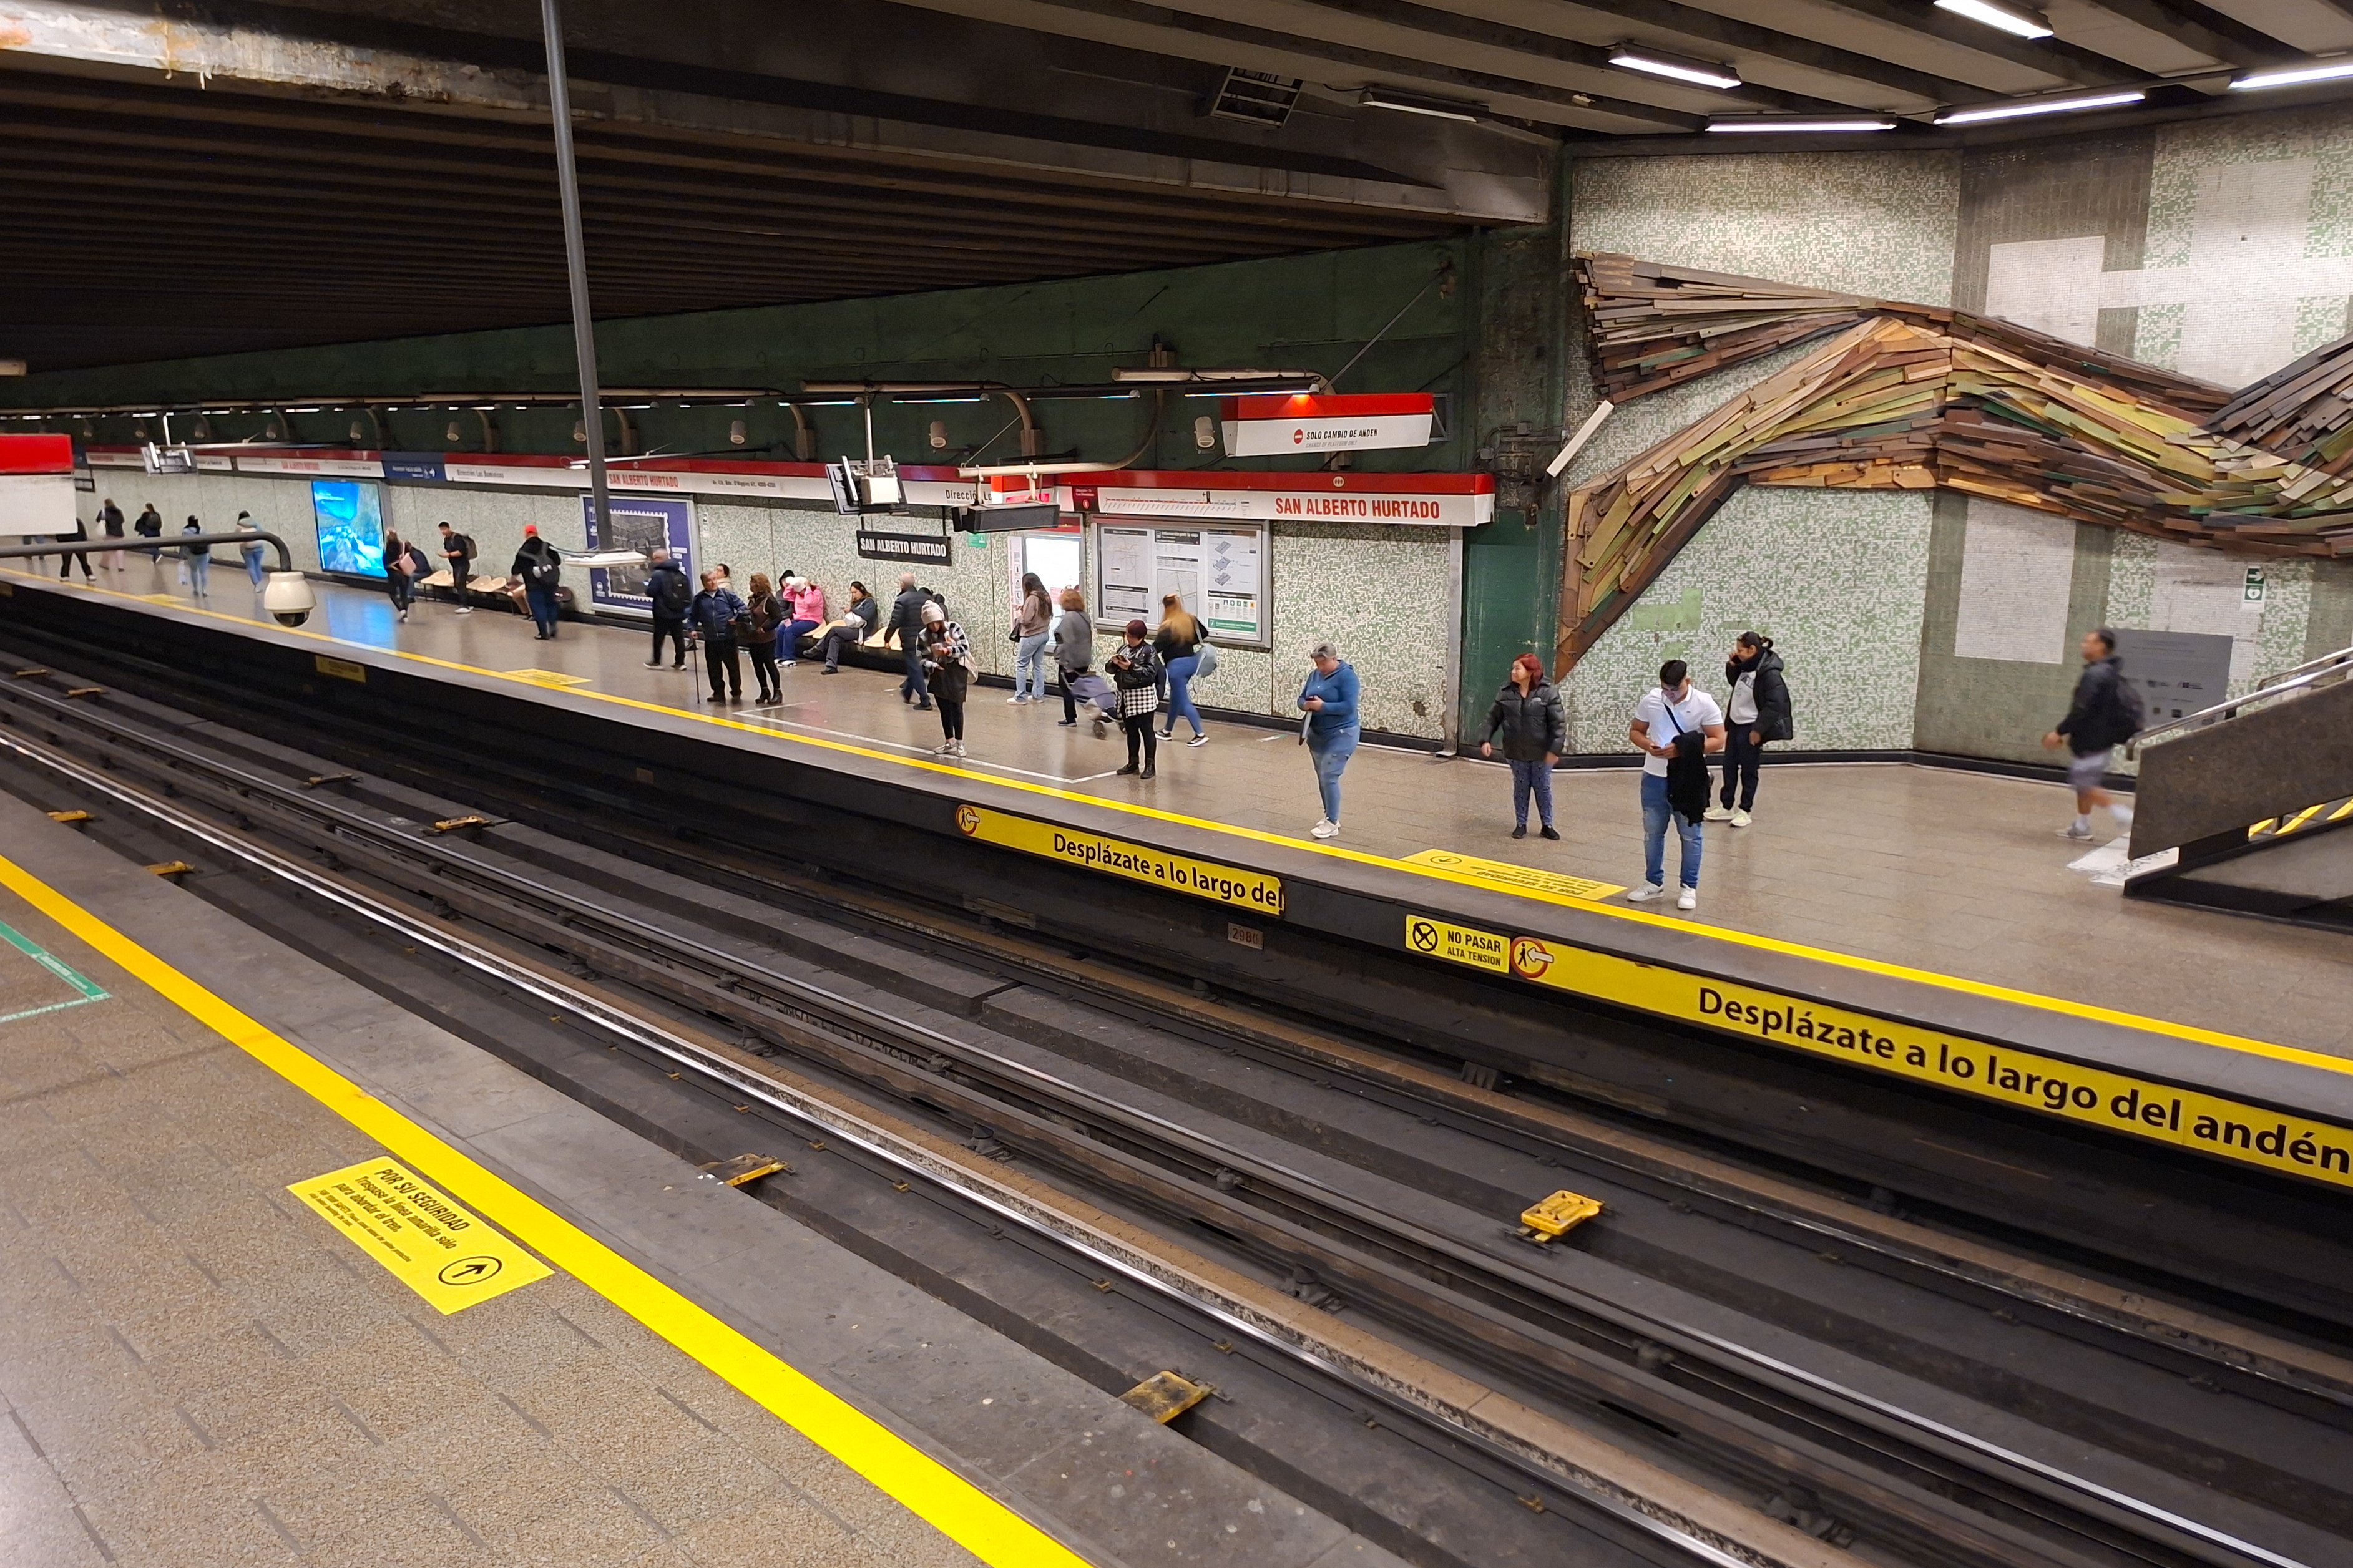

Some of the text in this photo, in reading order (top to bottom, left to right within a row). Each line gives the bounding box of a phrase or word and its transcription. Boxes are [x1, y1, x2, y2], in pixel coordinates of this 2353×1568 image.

[1306, 429, 1378, 440] SOLO CAMBIO DE ANDEN
[609, 474, 679, 488] SAN ALBERTO HURTADO
[946, 489, 992, 501] Direcció Lo
[1276, 497, 1440, 519] SAN ALBERTO HURTADO
[860, 537, 946, 557] SAN ALBERTO HURTADO
[1054, 833, 1283, 908] Desplázate a lo largo del
[1447, 930, 1501, 953] NO PASAR
[1447, 946, 1501, 967] ALTA TENSION
[1699, 987, 2351, 1174] Desplázate a lo largo del andén
[331, 1183, 356, 1195] para
[349, 1194, 381, 1214] abordar
[382, 1217, 403, 1233] tren.
[374, 1169, 471, 1231] POR SU SEGURIDAD
[355, 1176, 457, 1249] Traspase la línea amarilla sólo
